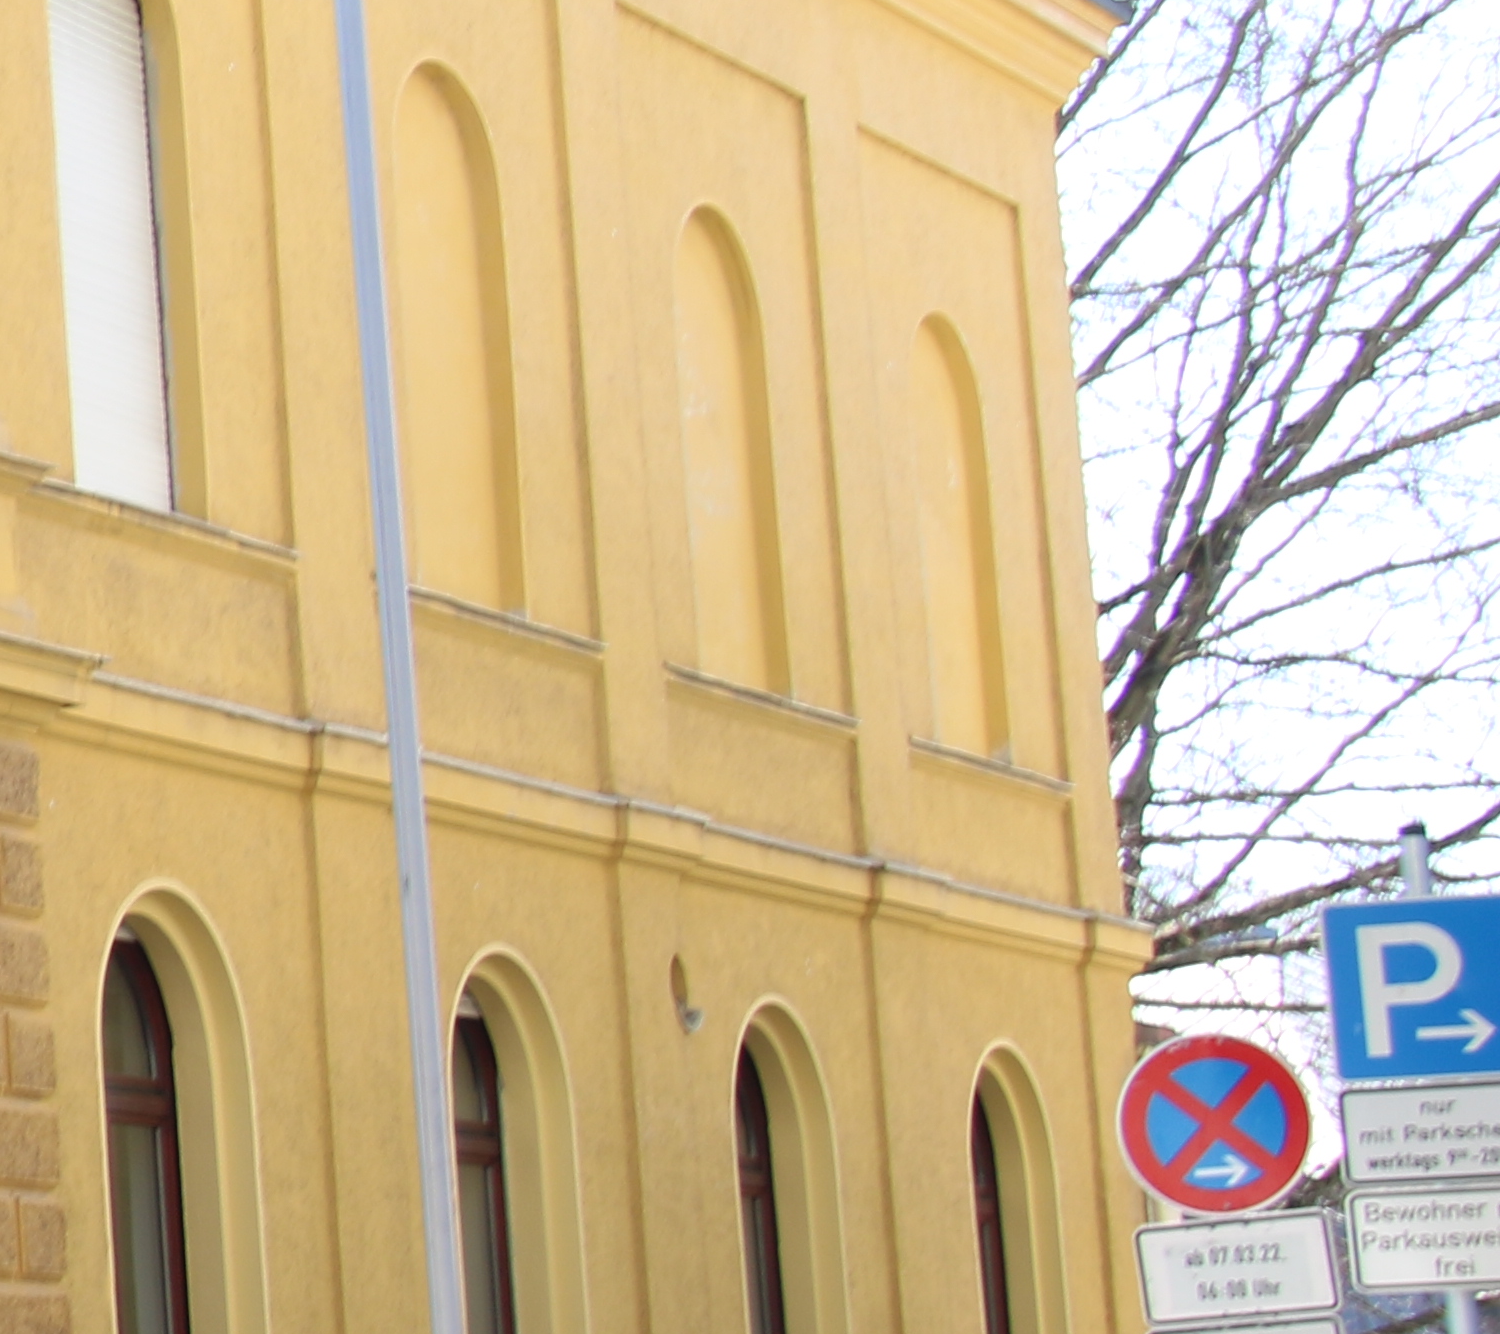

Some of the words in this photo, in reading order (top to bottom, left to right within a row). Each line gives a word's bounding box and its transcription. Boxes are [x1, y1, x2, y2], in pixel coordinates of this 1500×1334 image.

[1355, 921, 1463, 1058] P
[1419, 1098, 1456, 1115] nur
[1359, 1126, 1394, 1145] mit
[1363, 1199, 1488, 1224] Bewohner
[1434, 1254, 1476, 1277] frei
